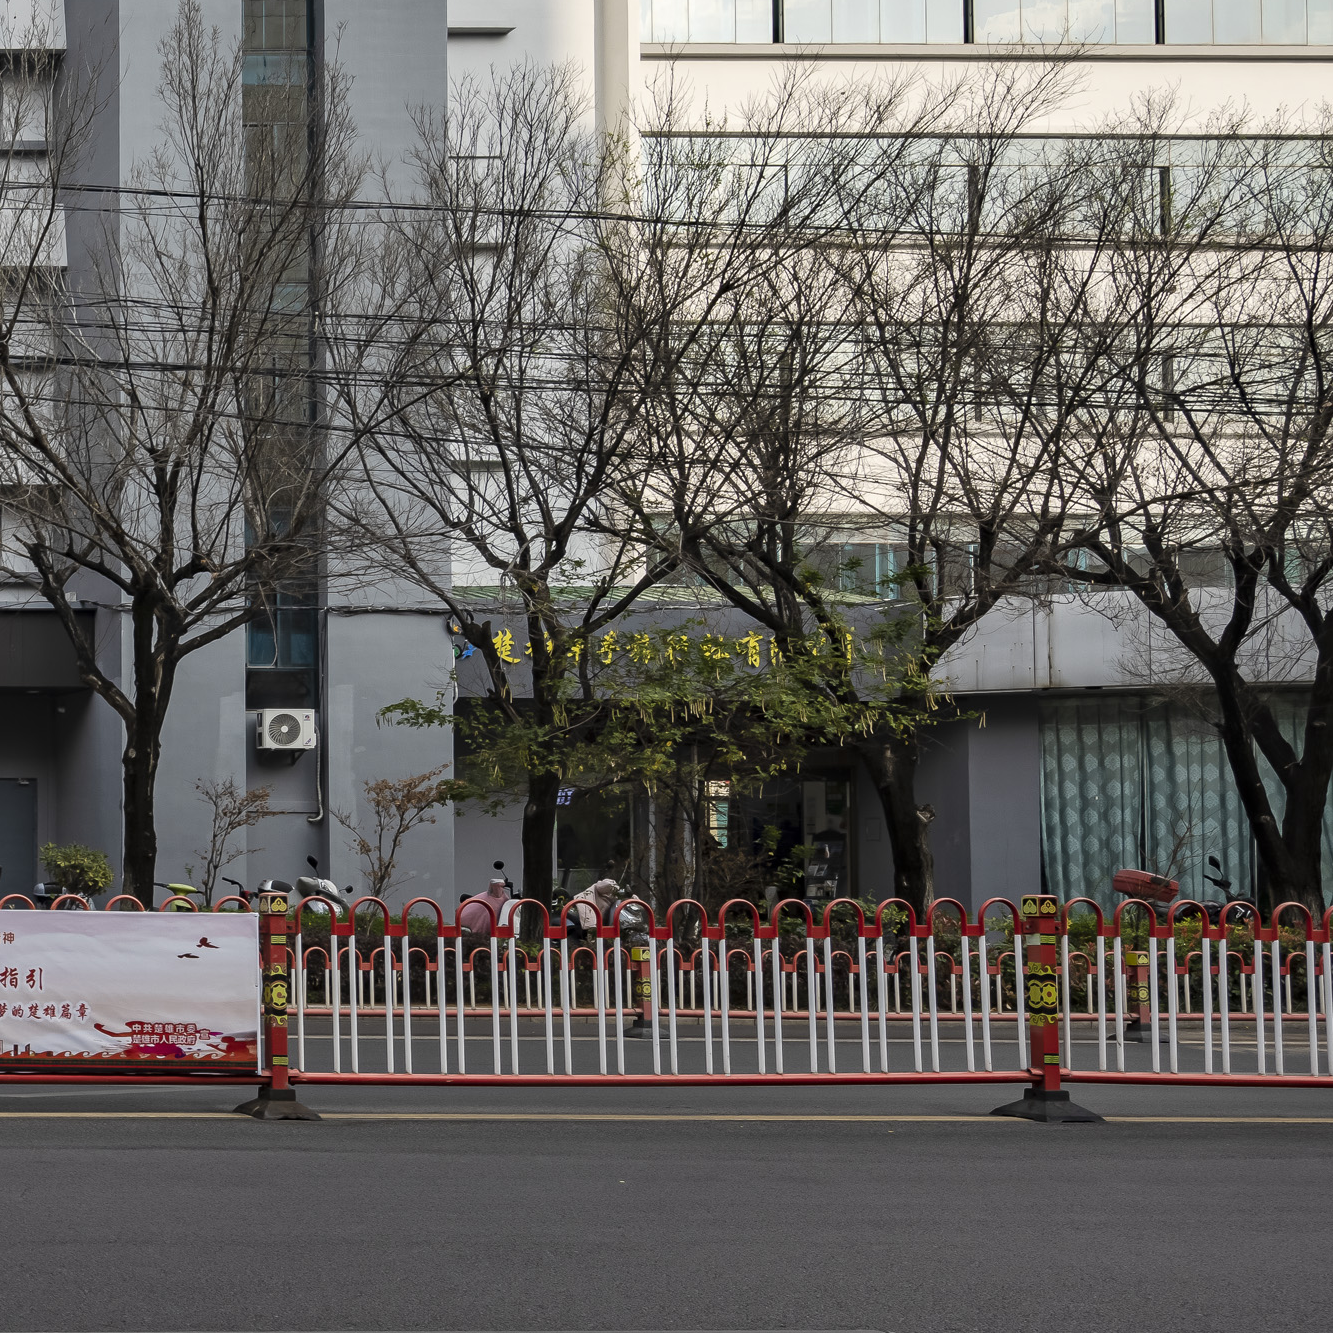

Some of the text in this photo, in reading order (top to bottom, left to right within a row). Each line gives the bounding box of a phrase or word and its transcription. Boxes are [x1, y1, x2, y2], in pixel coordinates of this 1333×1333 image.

[131, 1023, 196, 1034] 中共楚雄市委
[131, 1034, 196, 1045] 楚雄市人民政府
